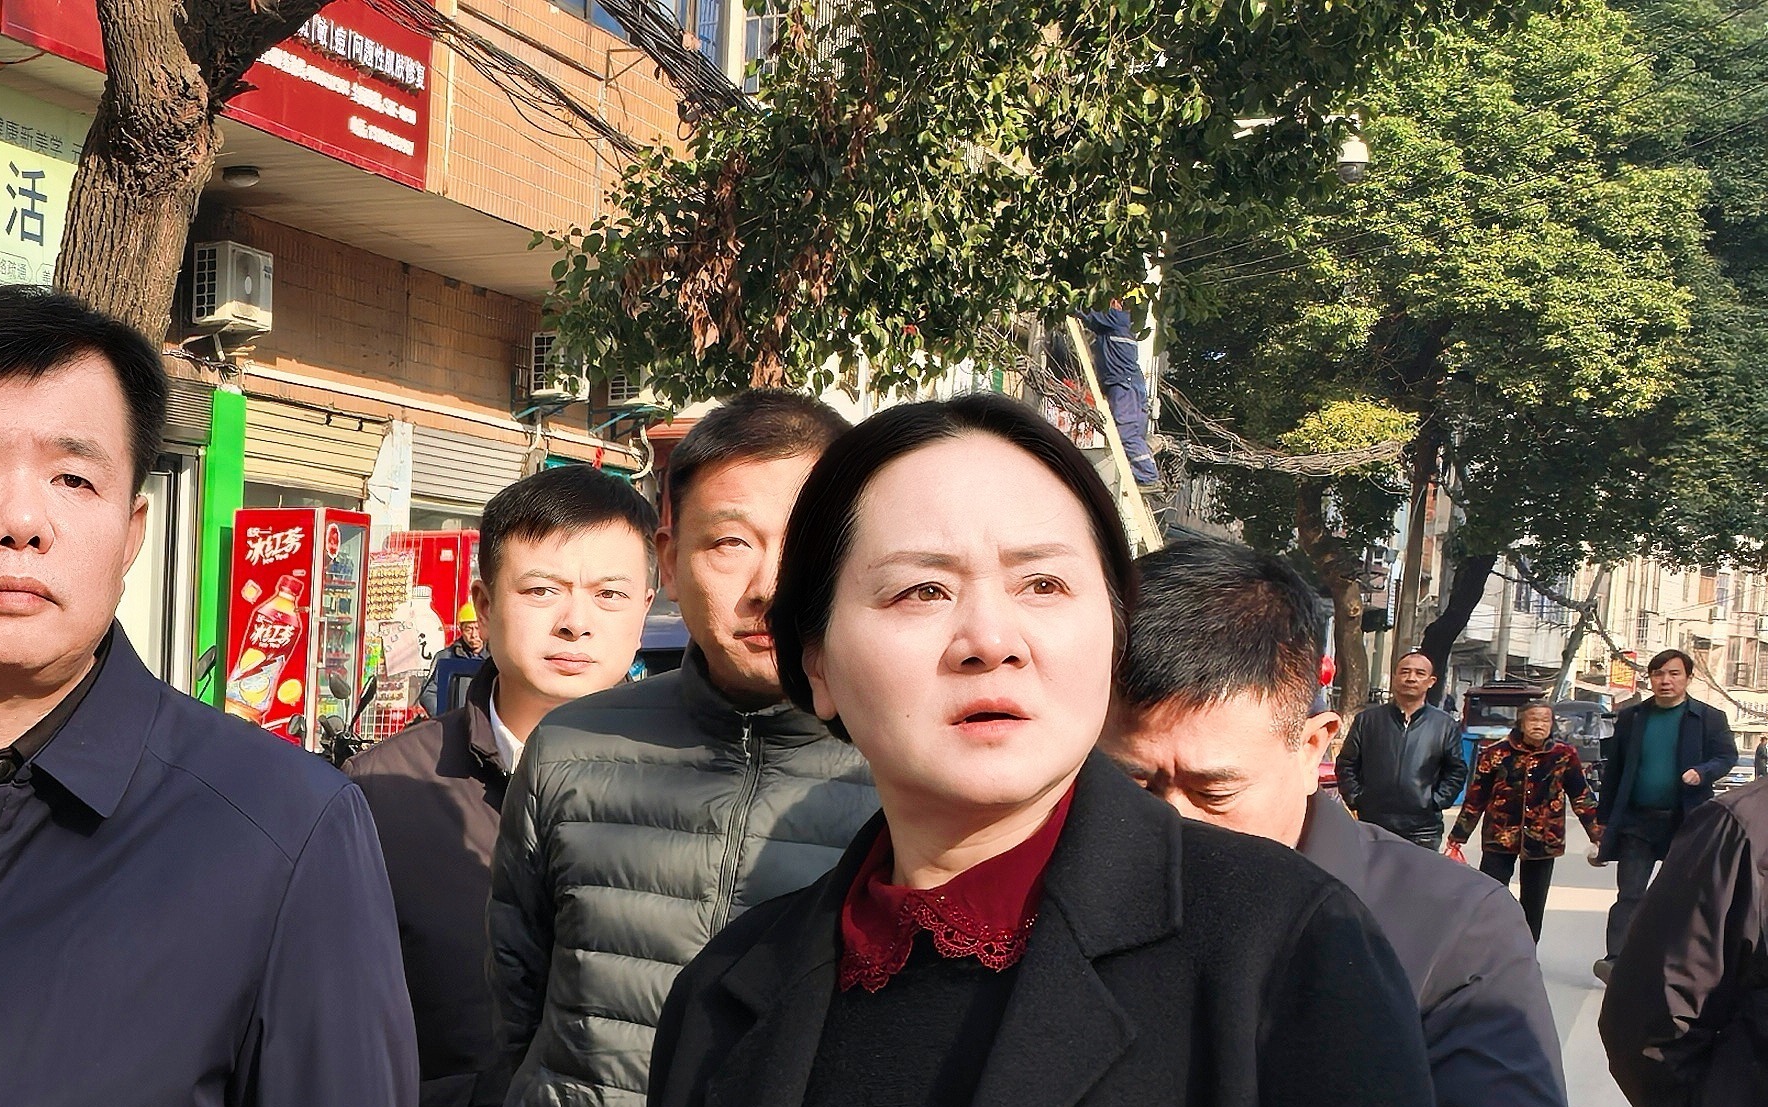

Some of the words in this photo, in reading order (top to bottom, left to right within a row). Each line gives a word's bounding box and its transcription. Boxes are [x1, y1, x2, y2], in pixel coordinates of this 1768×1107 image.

[245, 526, 305, 567] 冰红茶
[250, 624, 295, 645] 冰红茶
